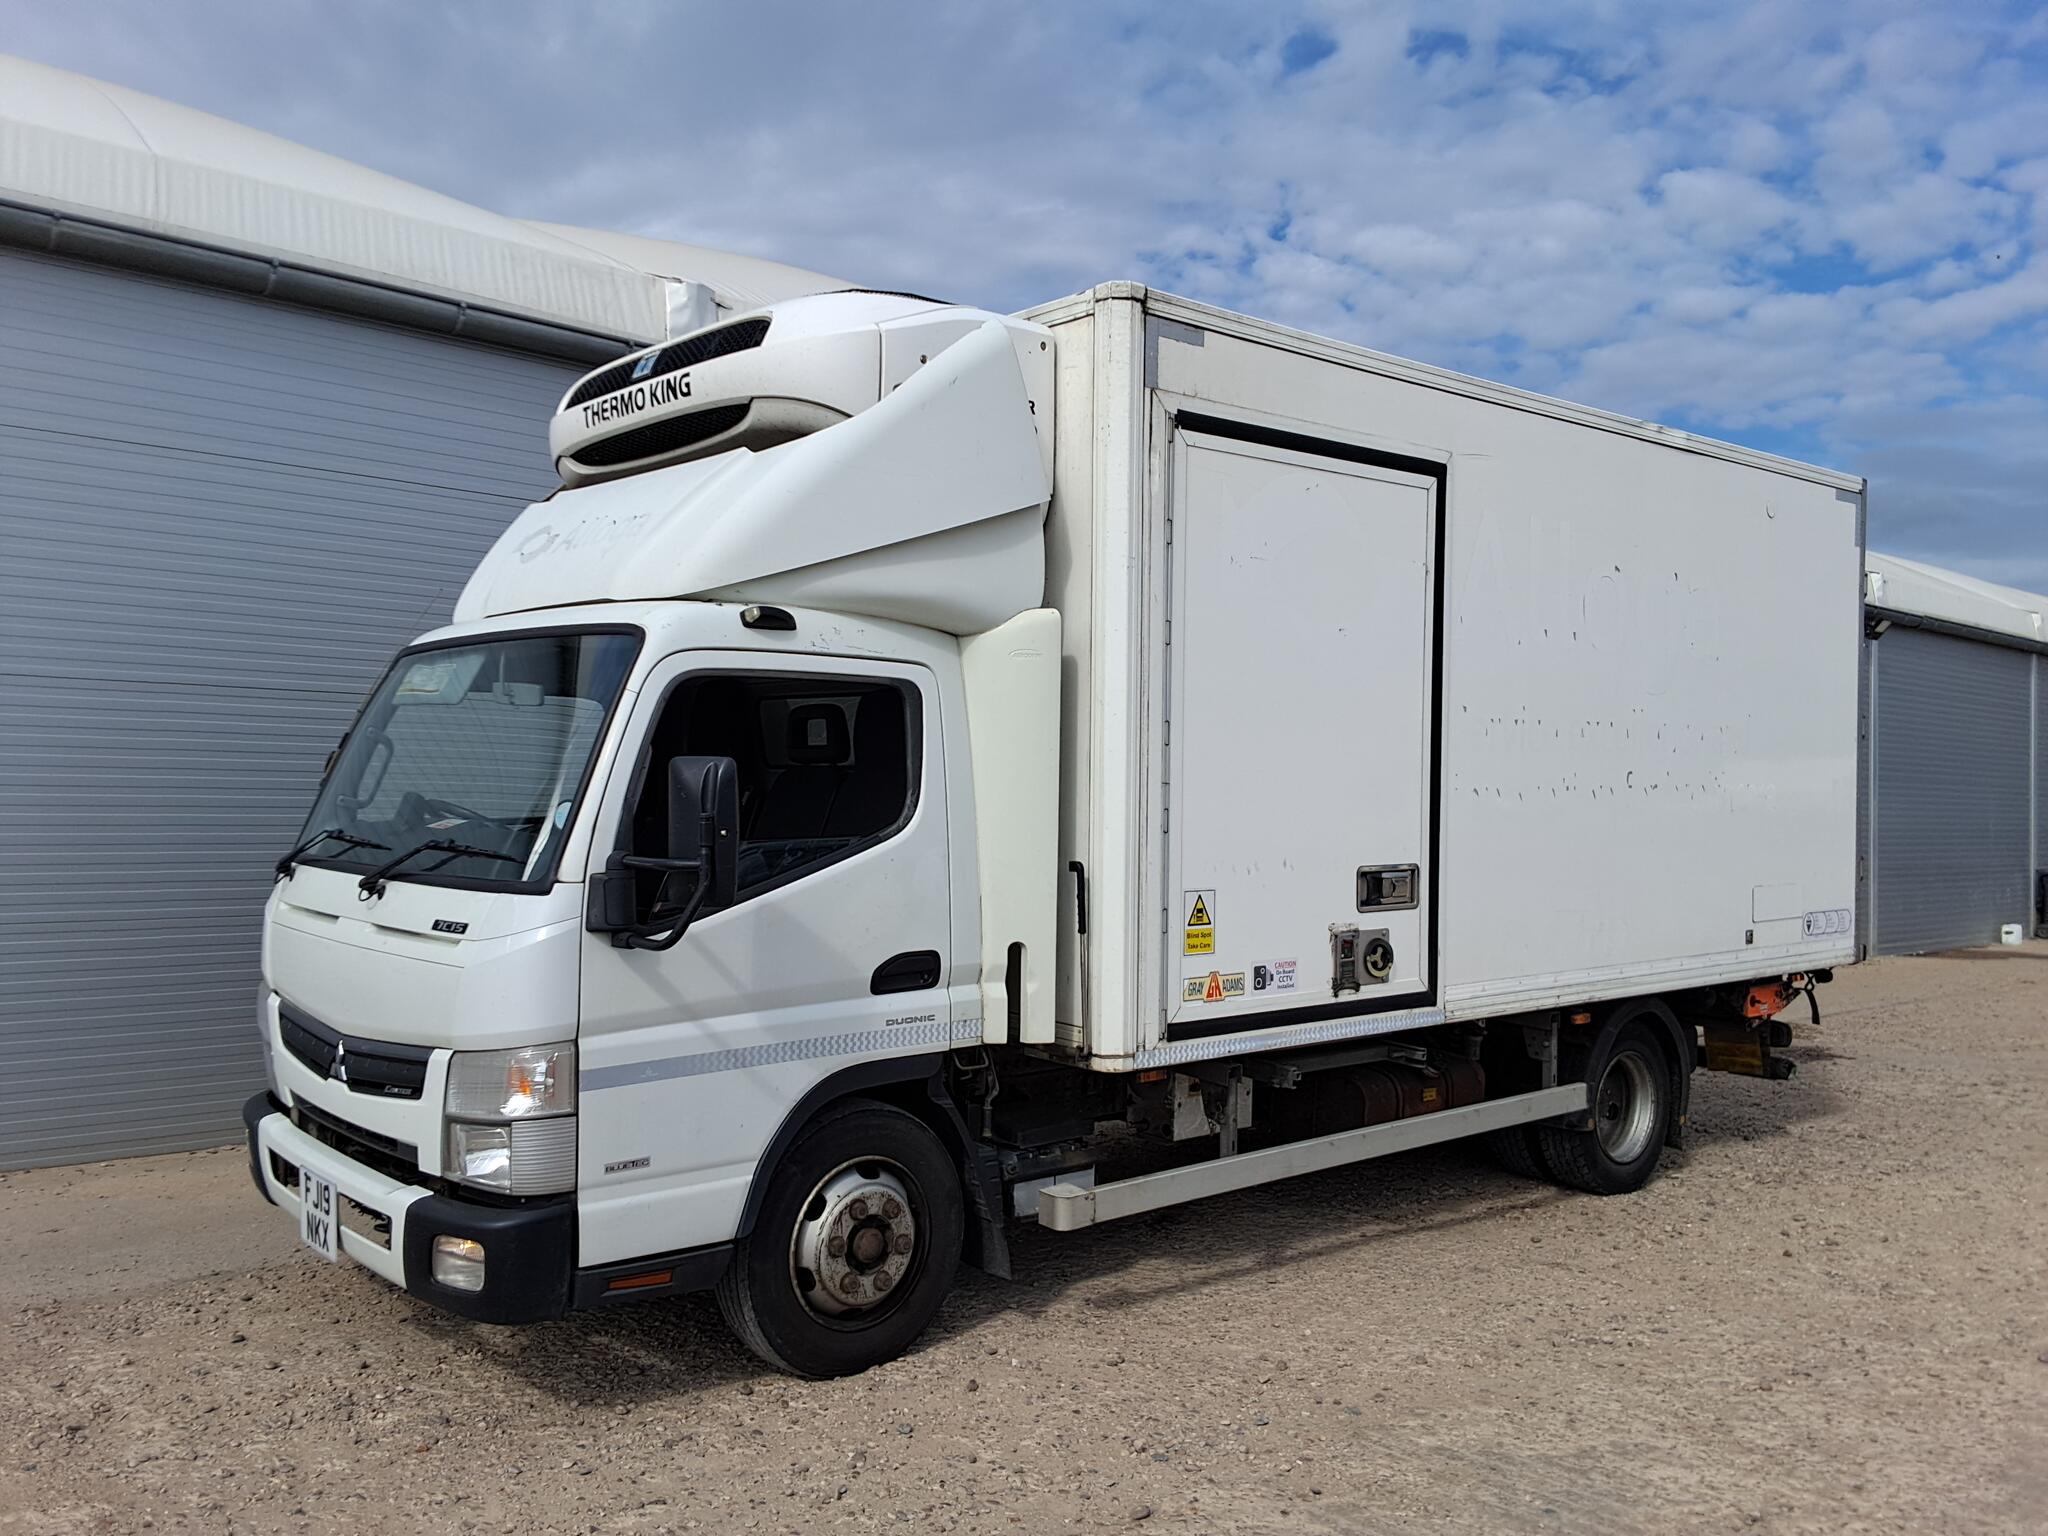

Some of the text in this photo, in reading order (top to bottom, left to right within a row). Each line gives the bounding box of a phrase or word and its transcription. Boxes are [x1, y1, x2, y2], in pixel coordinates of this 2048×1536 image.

[583, 371, 692, 429] THERMO KING
[1274, 960, 1296, 969] CAUTION
[1188, 982, 1205, 996] GRAY
[1222, 977, 1243, 992] ADAMS
[1278, 975, 1293, 983] CCTV
[886, 1014, 936, 1027] DUONIC
[304, 1172, 330, 1216] FJ19
[307, 1210, 329, 1252] NKX
